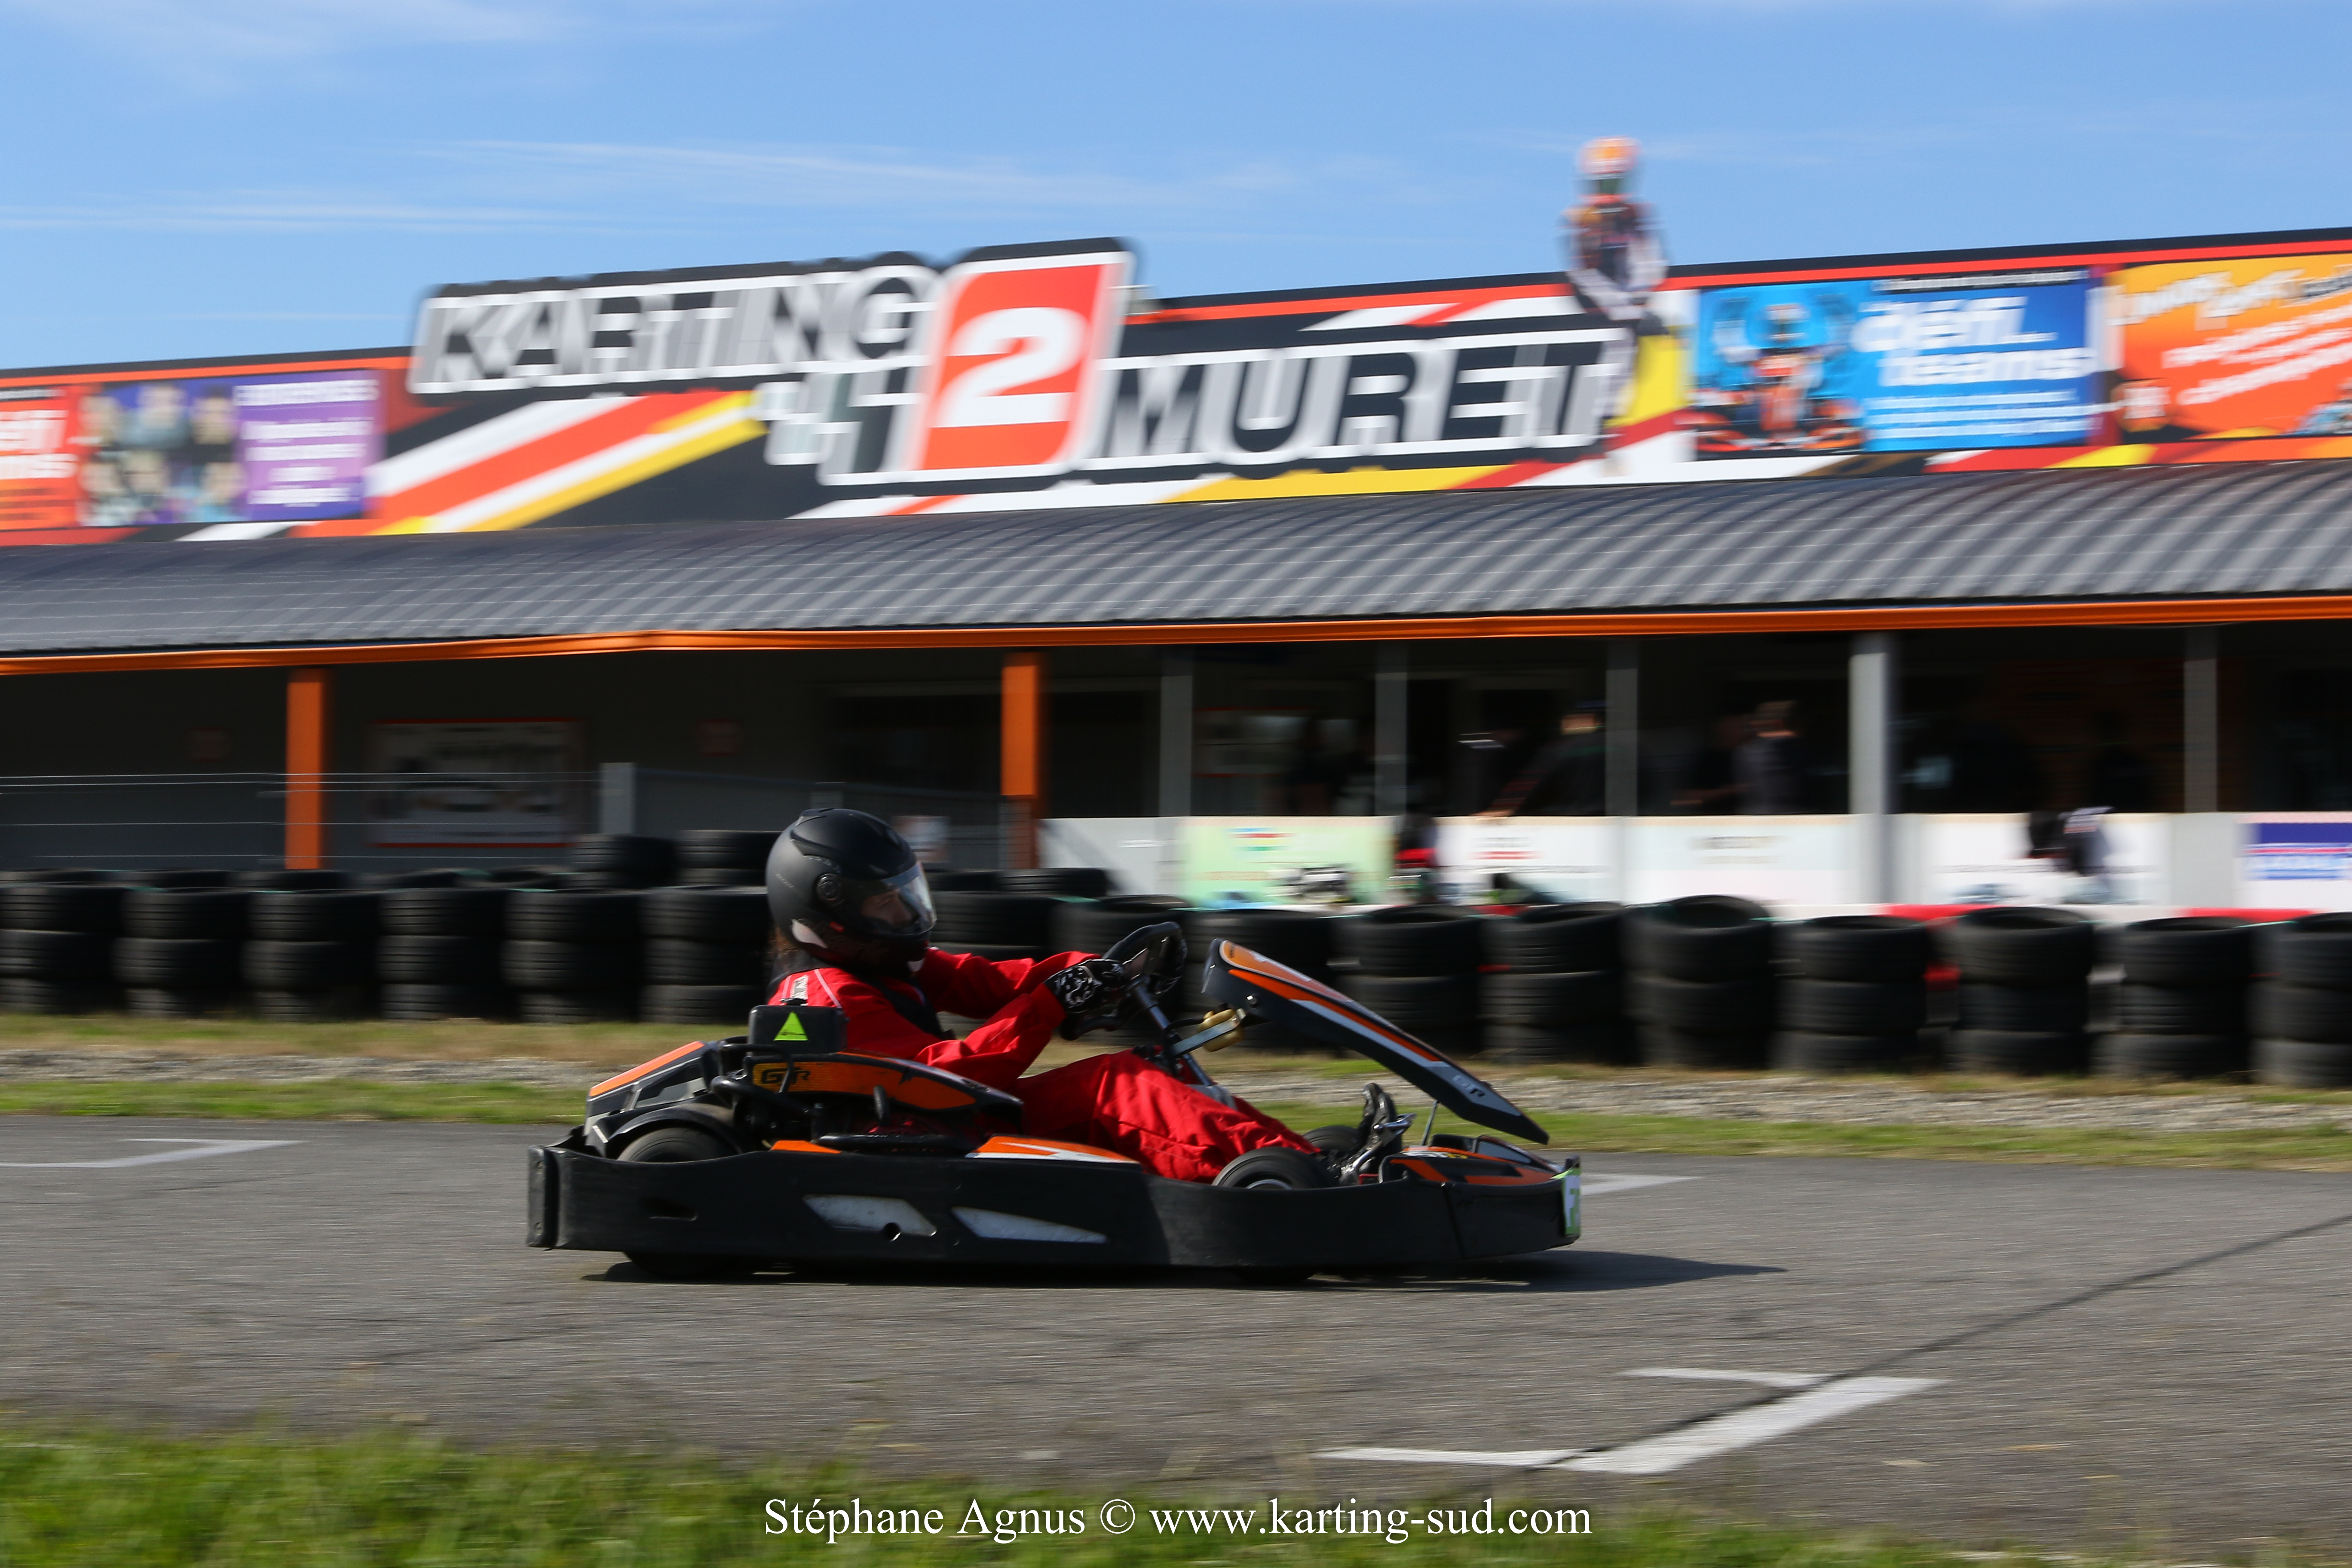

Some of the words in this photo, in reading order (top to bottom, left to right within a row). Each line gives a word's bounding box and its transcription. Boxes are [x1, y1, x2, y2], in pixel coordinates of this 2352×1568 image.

[422, 267, 931, 388] KARTING
[940, 306, 1094, 425] 2
[1094, 331, 1625, 462] MURET
